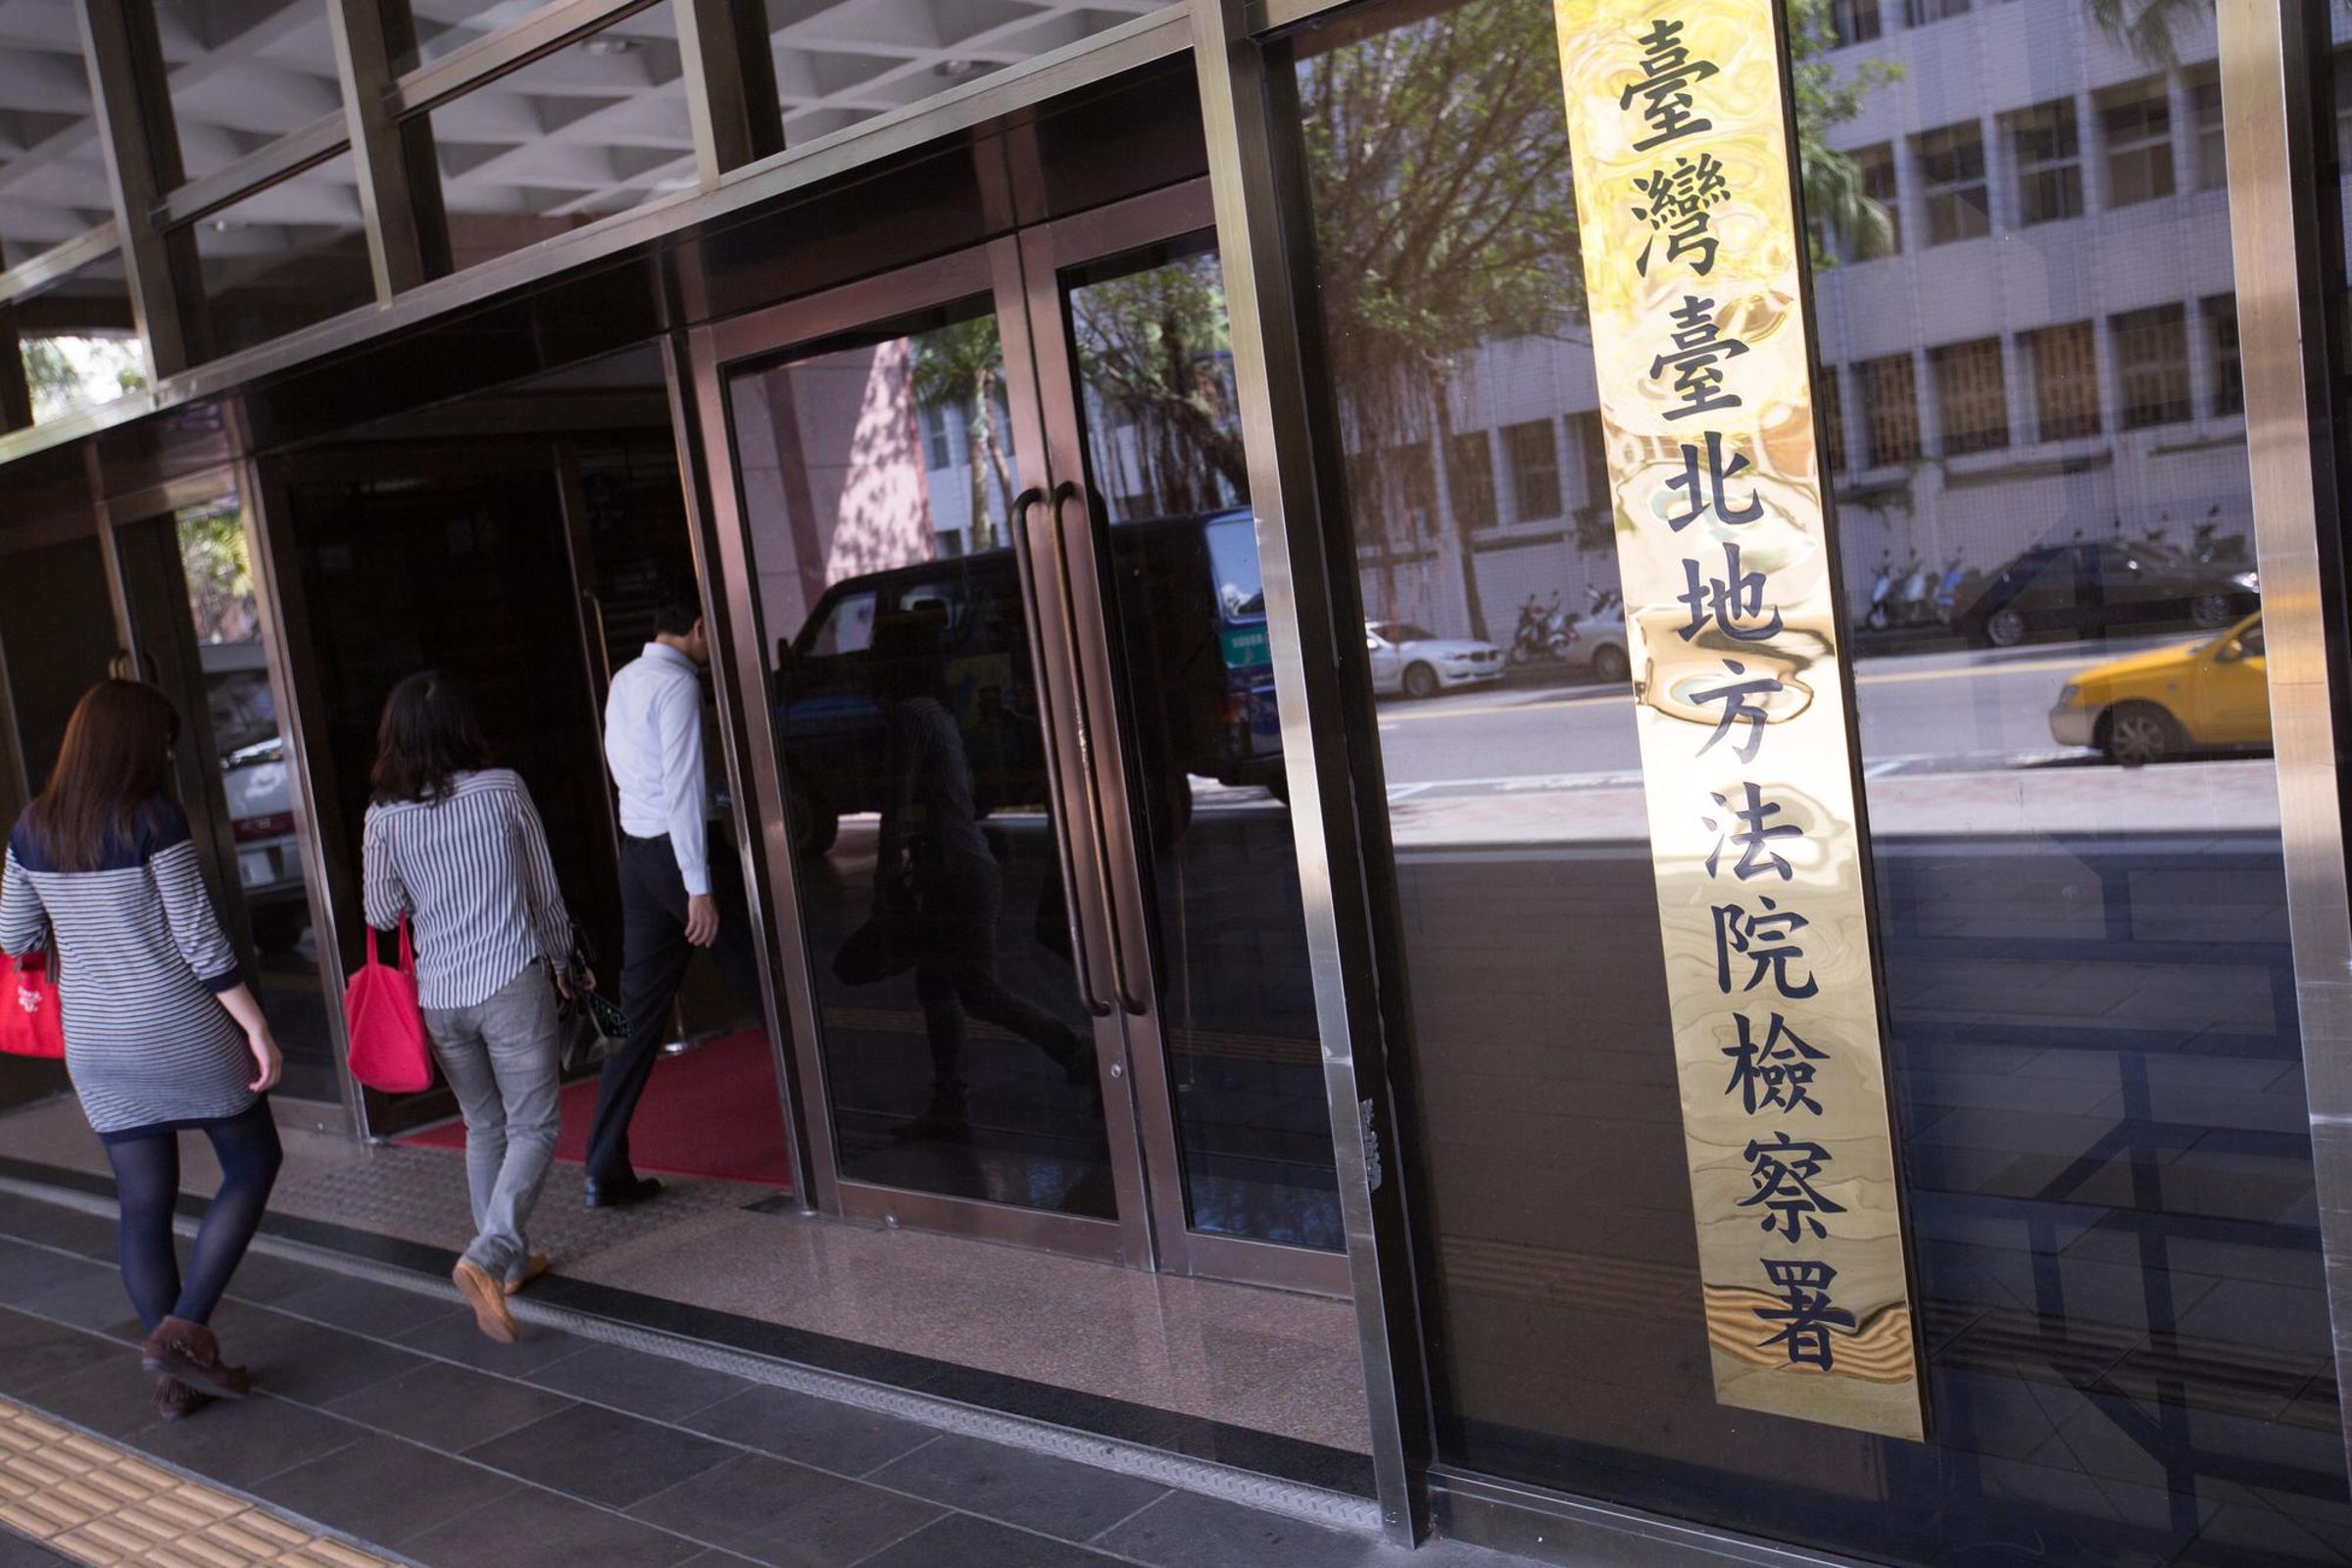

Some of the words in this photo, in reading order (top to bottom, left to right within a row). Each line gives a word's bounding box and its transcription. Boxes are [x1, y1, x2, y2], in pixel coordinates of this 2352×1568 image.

[1621, 20, 1856, 1372] 臺灣臺北地方法院檢察署
